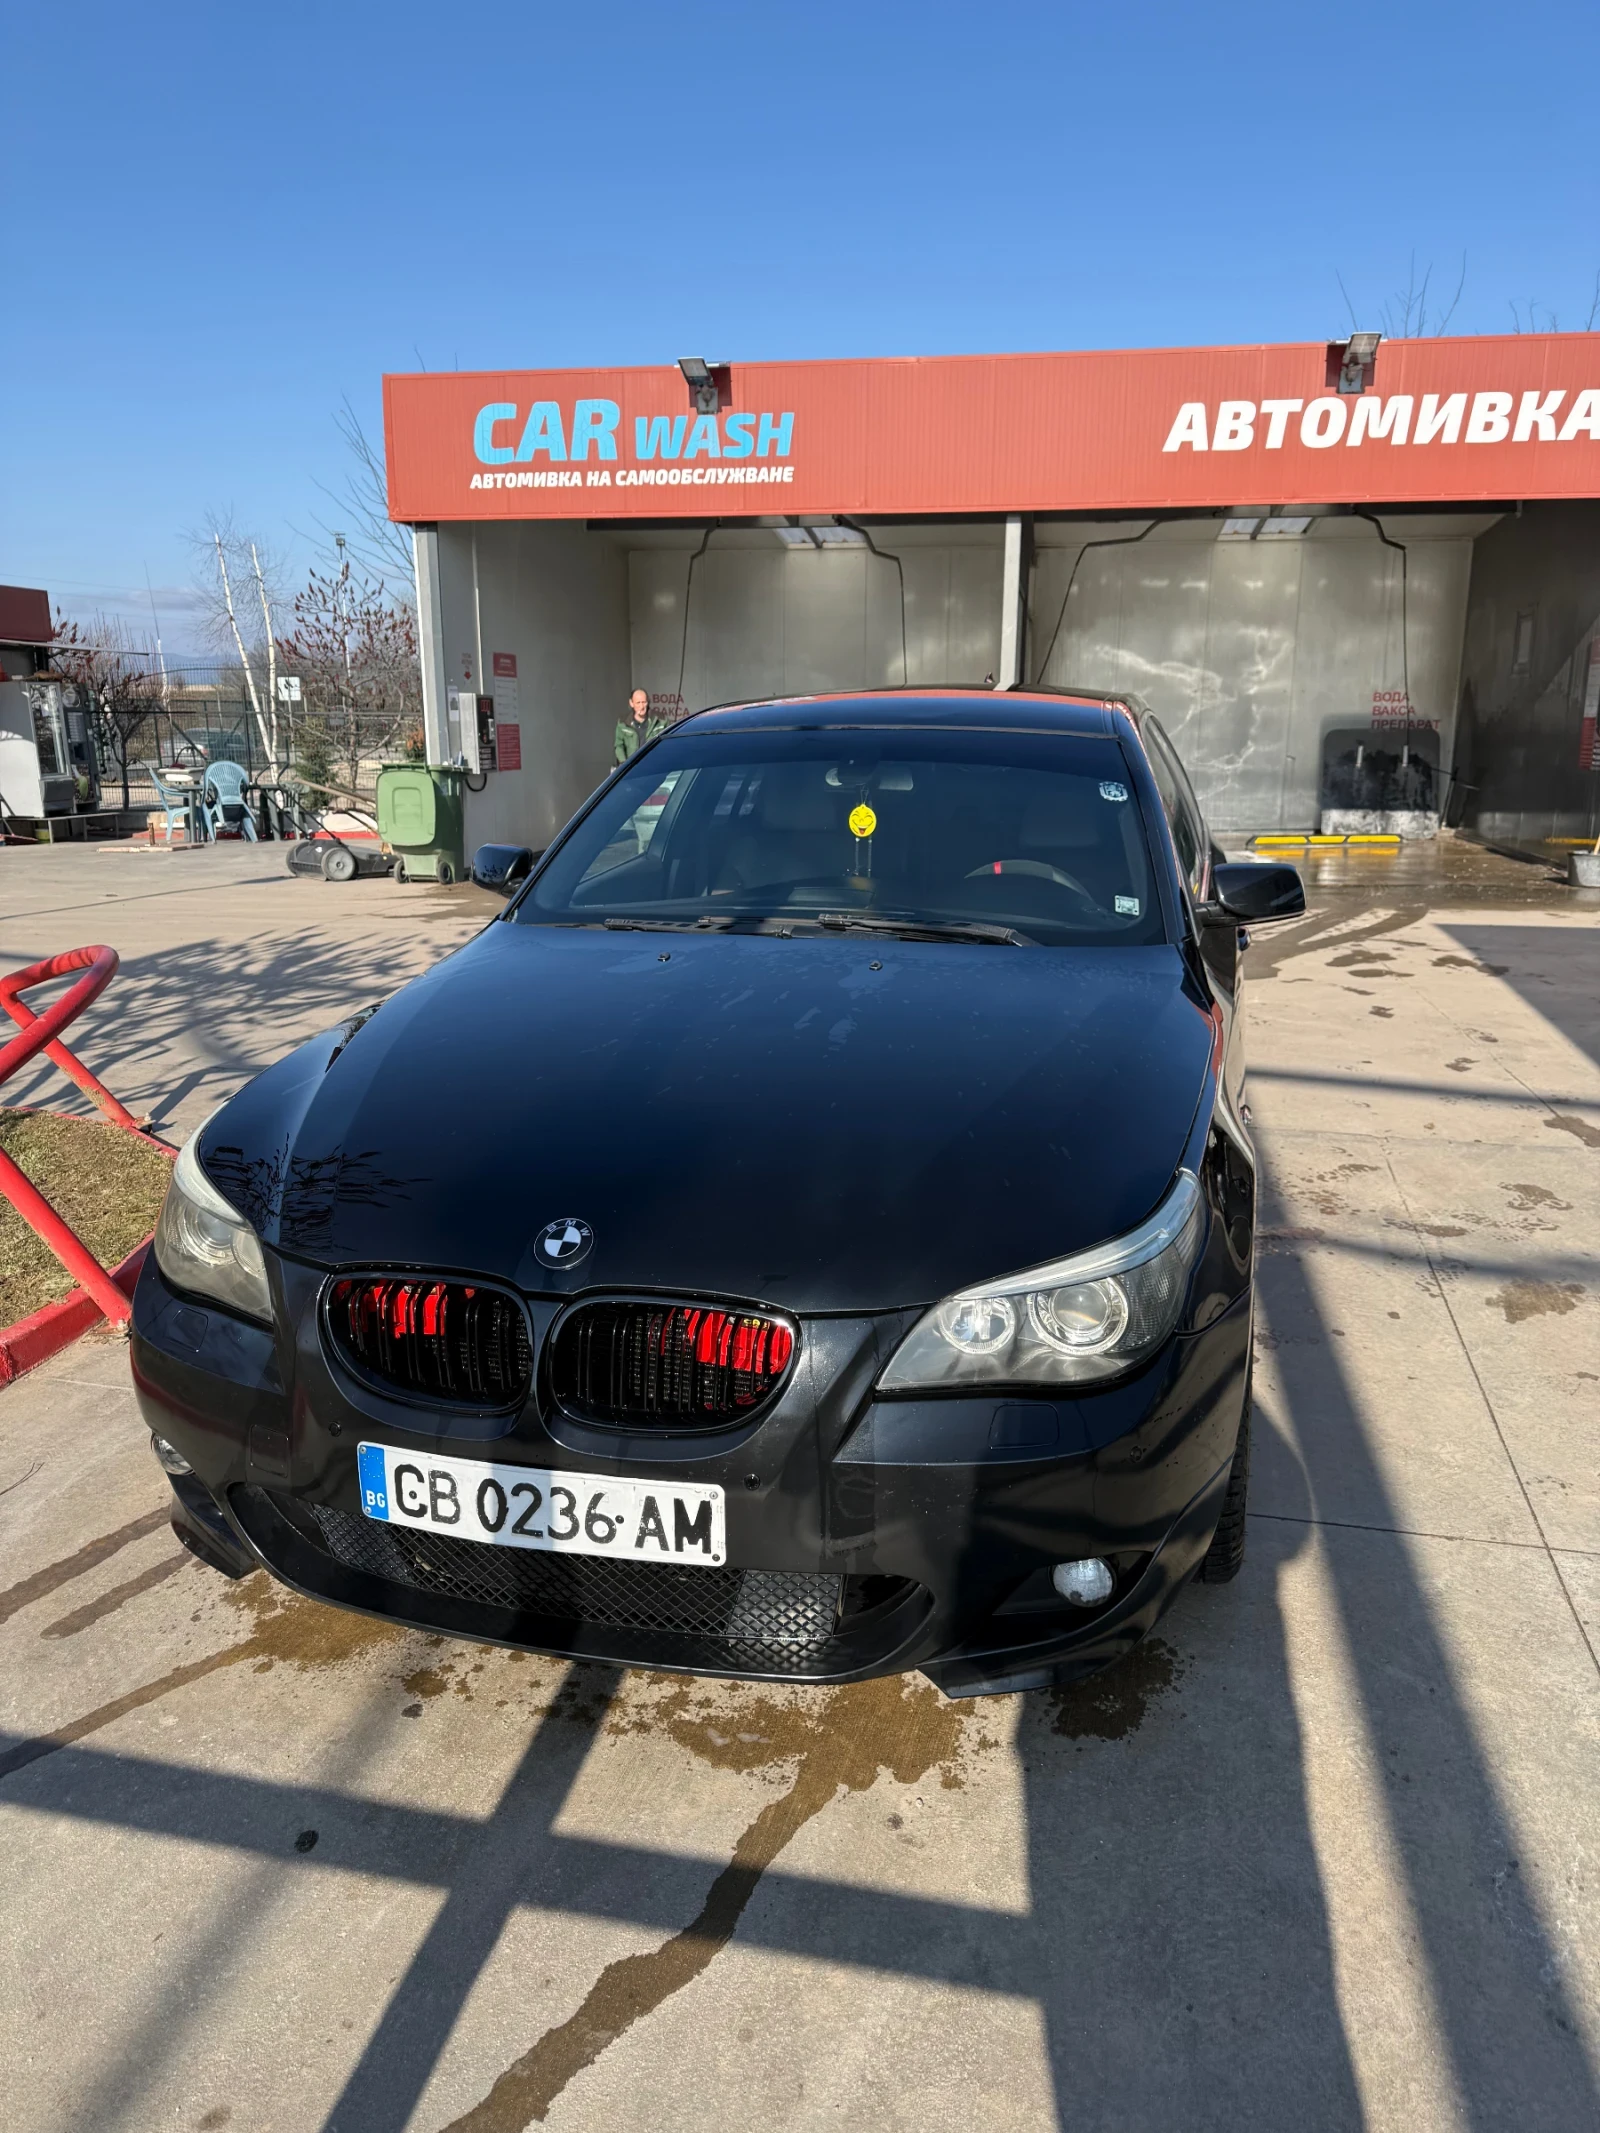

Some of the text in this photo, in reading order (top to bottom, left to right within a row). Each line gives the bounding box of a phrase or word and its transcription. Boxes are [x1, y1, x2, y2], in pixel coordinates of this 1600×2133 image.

[1162, 389, 1600, 452] АВТОМИВКА
[473, 398, 795, 464] CAR WASH
[470, 465, 795, 490] АВТОМИВКА НА САМООБСЛУЖВАНЕ
[652, 693, 684, 704] ВОДА
[1372, 691, 1410, 703] ВОДА
[1372, 705, 1416, 716] ВАКСА
[1371, 719, 1442, 730] ПРЕПАРАТ
[547, 1219, 591, 1237] BMW
[366, 1490, 386, 1508] BG
[393, 1464, 713, 1555] CB 0236 AM
